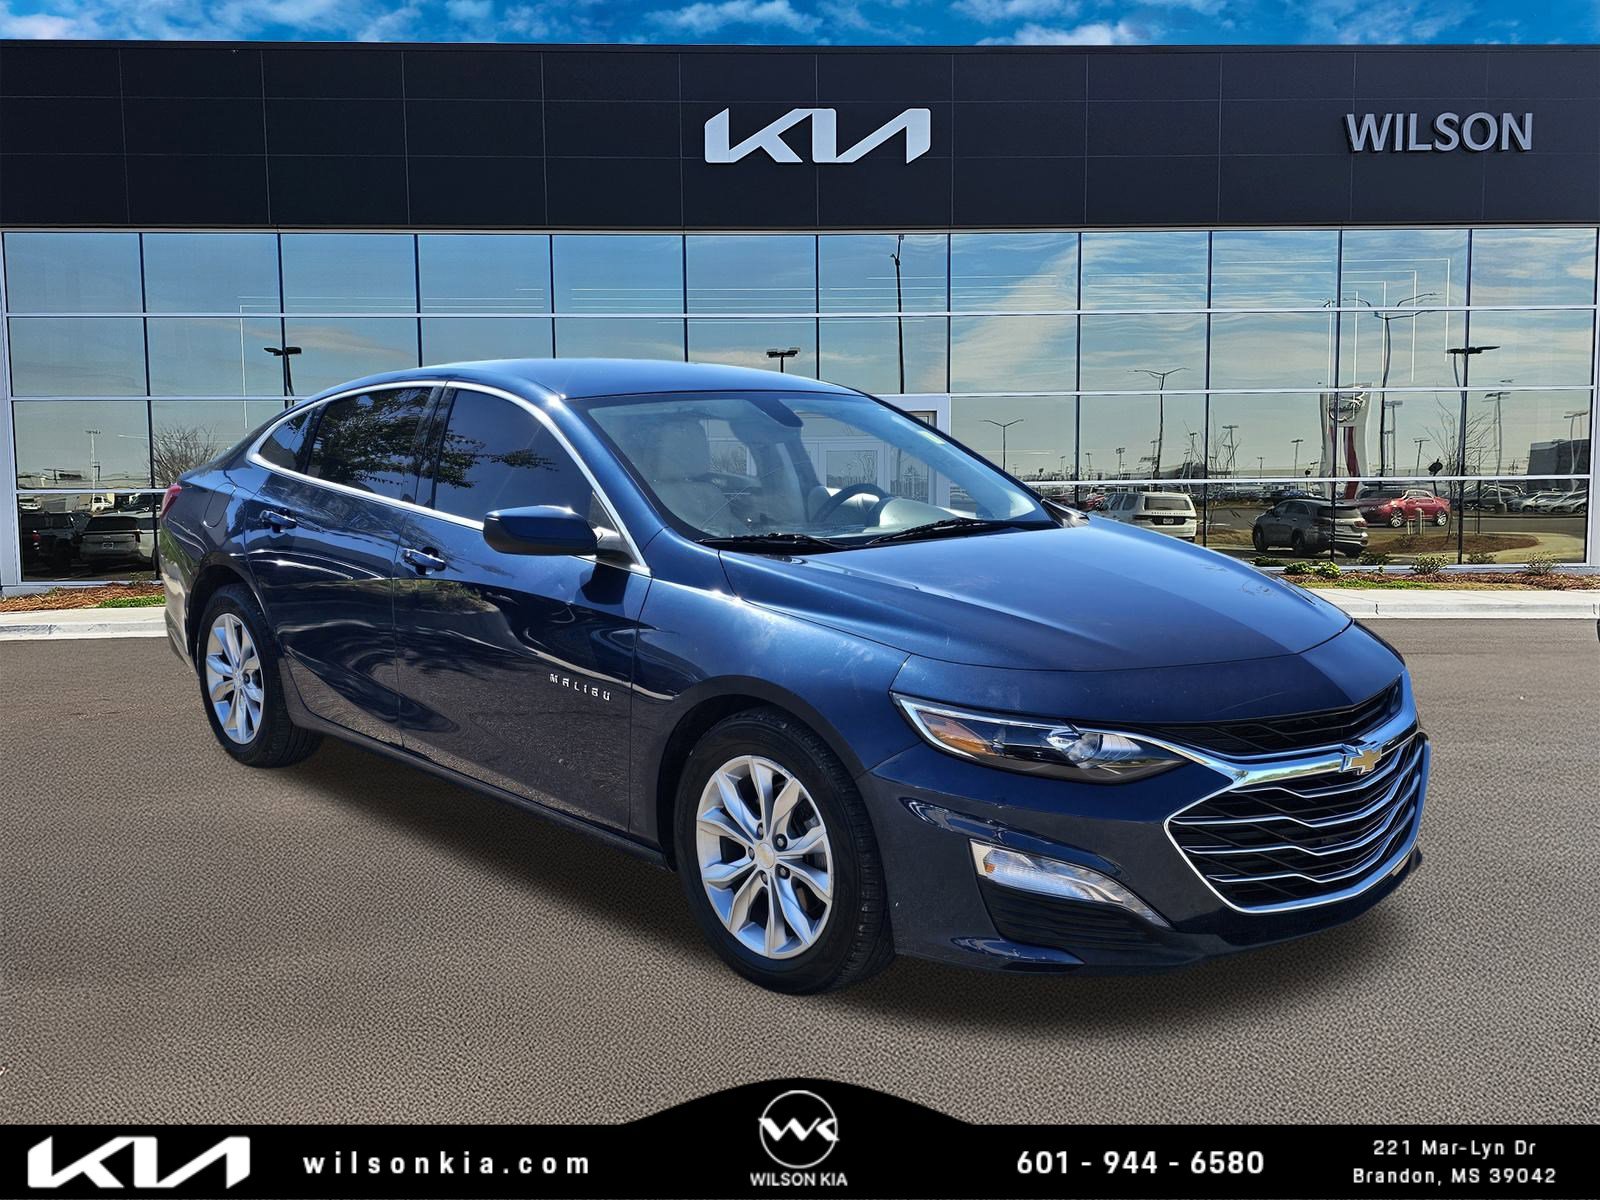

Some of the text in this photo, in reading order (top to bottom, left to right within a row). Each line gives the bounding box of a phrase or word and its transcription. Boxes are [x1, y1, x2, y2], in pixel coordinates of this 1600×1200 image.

[704, 107, 931, 164] KIA
[1346, 112, 1534, 153] WILSON
[549, 673, 611, 701] MALIBU
